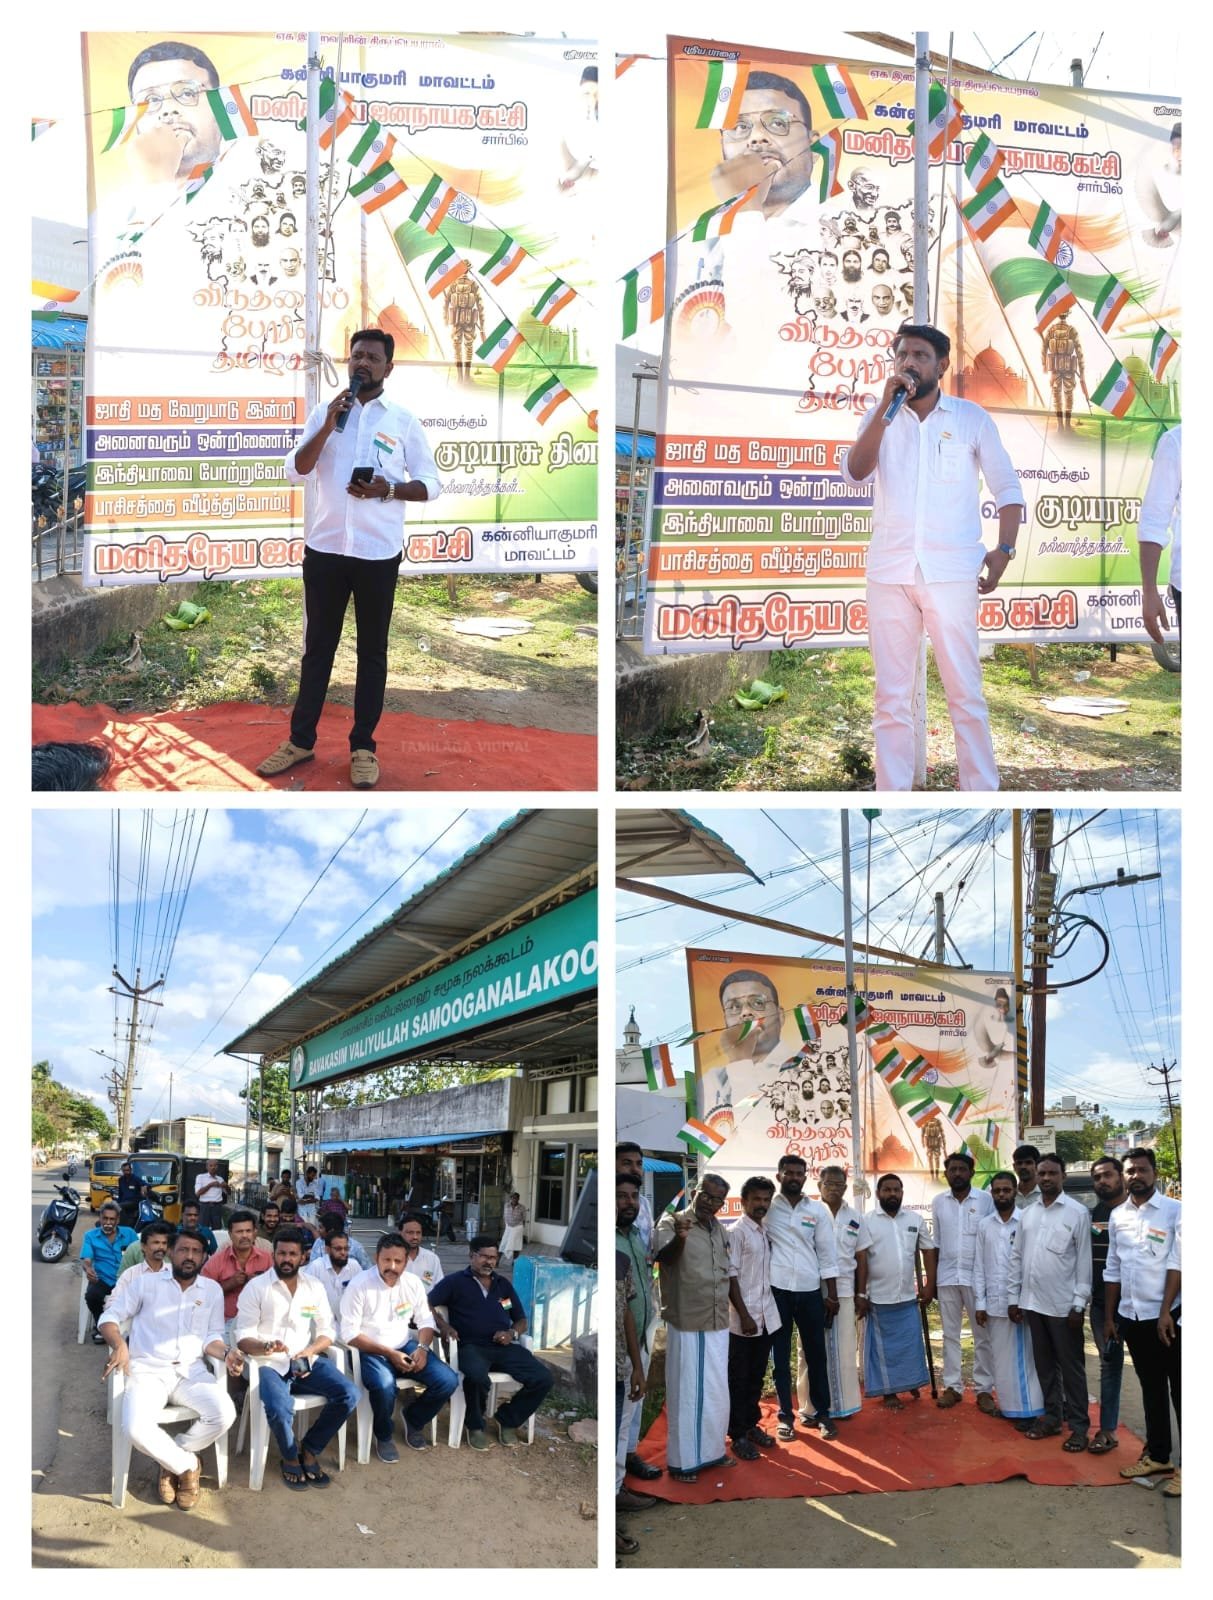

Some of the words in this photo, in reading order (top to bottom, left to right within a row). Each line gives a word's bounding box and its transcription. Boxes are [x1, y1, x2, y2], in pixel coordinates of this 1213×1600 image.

[419, 74, 495, 90] மாவட்டம்
[476, 101, 528, 131] கட்சி
[481, 133, 528, 147] சார்பில்
[1014, 118, 1089, 139] மாவட்டம்
[1071, 150, 1122, 179] கட்சி
[1077, 181, 1123, 195] சார்பில்
[95, 400, 131, 421] ஜாதி
[138, 402, 162, 420] மத
[168, 400, 239, 423] வேறுபாடு
[246, 400, 296, 420] இன்றி
[95, 430, 191, 452] அனைவரும்
[434, 439, 543, 474] குடியரசு
[665, 440, 707, 463] ஜாதி
[714, 444, 741, 464] மத
[748, 440, 827, 468] வேறுபாடு
[95, 463, 193, 485] இந்தியாவை
[664, 474, 773, 500] அனைவரும்
[95, 495, 176, 518] பாசிசத்தை
[182, 492, 291, 519] வீழ்த்துவோம்!!
[481, 524, 598, 543] கன்னியாகுமரி
[662, 510, 774, 537] இந்தியாவை
[95, 532, 257, 582] மனிதநேய
[407, 526, 474, 562] கட்சி
[504, 544, 577, 562] மாவட்டம்
[660, 547, 754, 574] பாசிசத்தை
[657, 591, 845, 650] மனிதநேய
[1007, 589, 1079, 630] கட்சி
[900, 992, 946, 1003] மாவட்டம்
[936, 1008, 967, 1027] கட்சி
[308, 1045, 348, 1077] BAVAKASIM
[349, 1019, 409, 1061] VALIYULLAH
